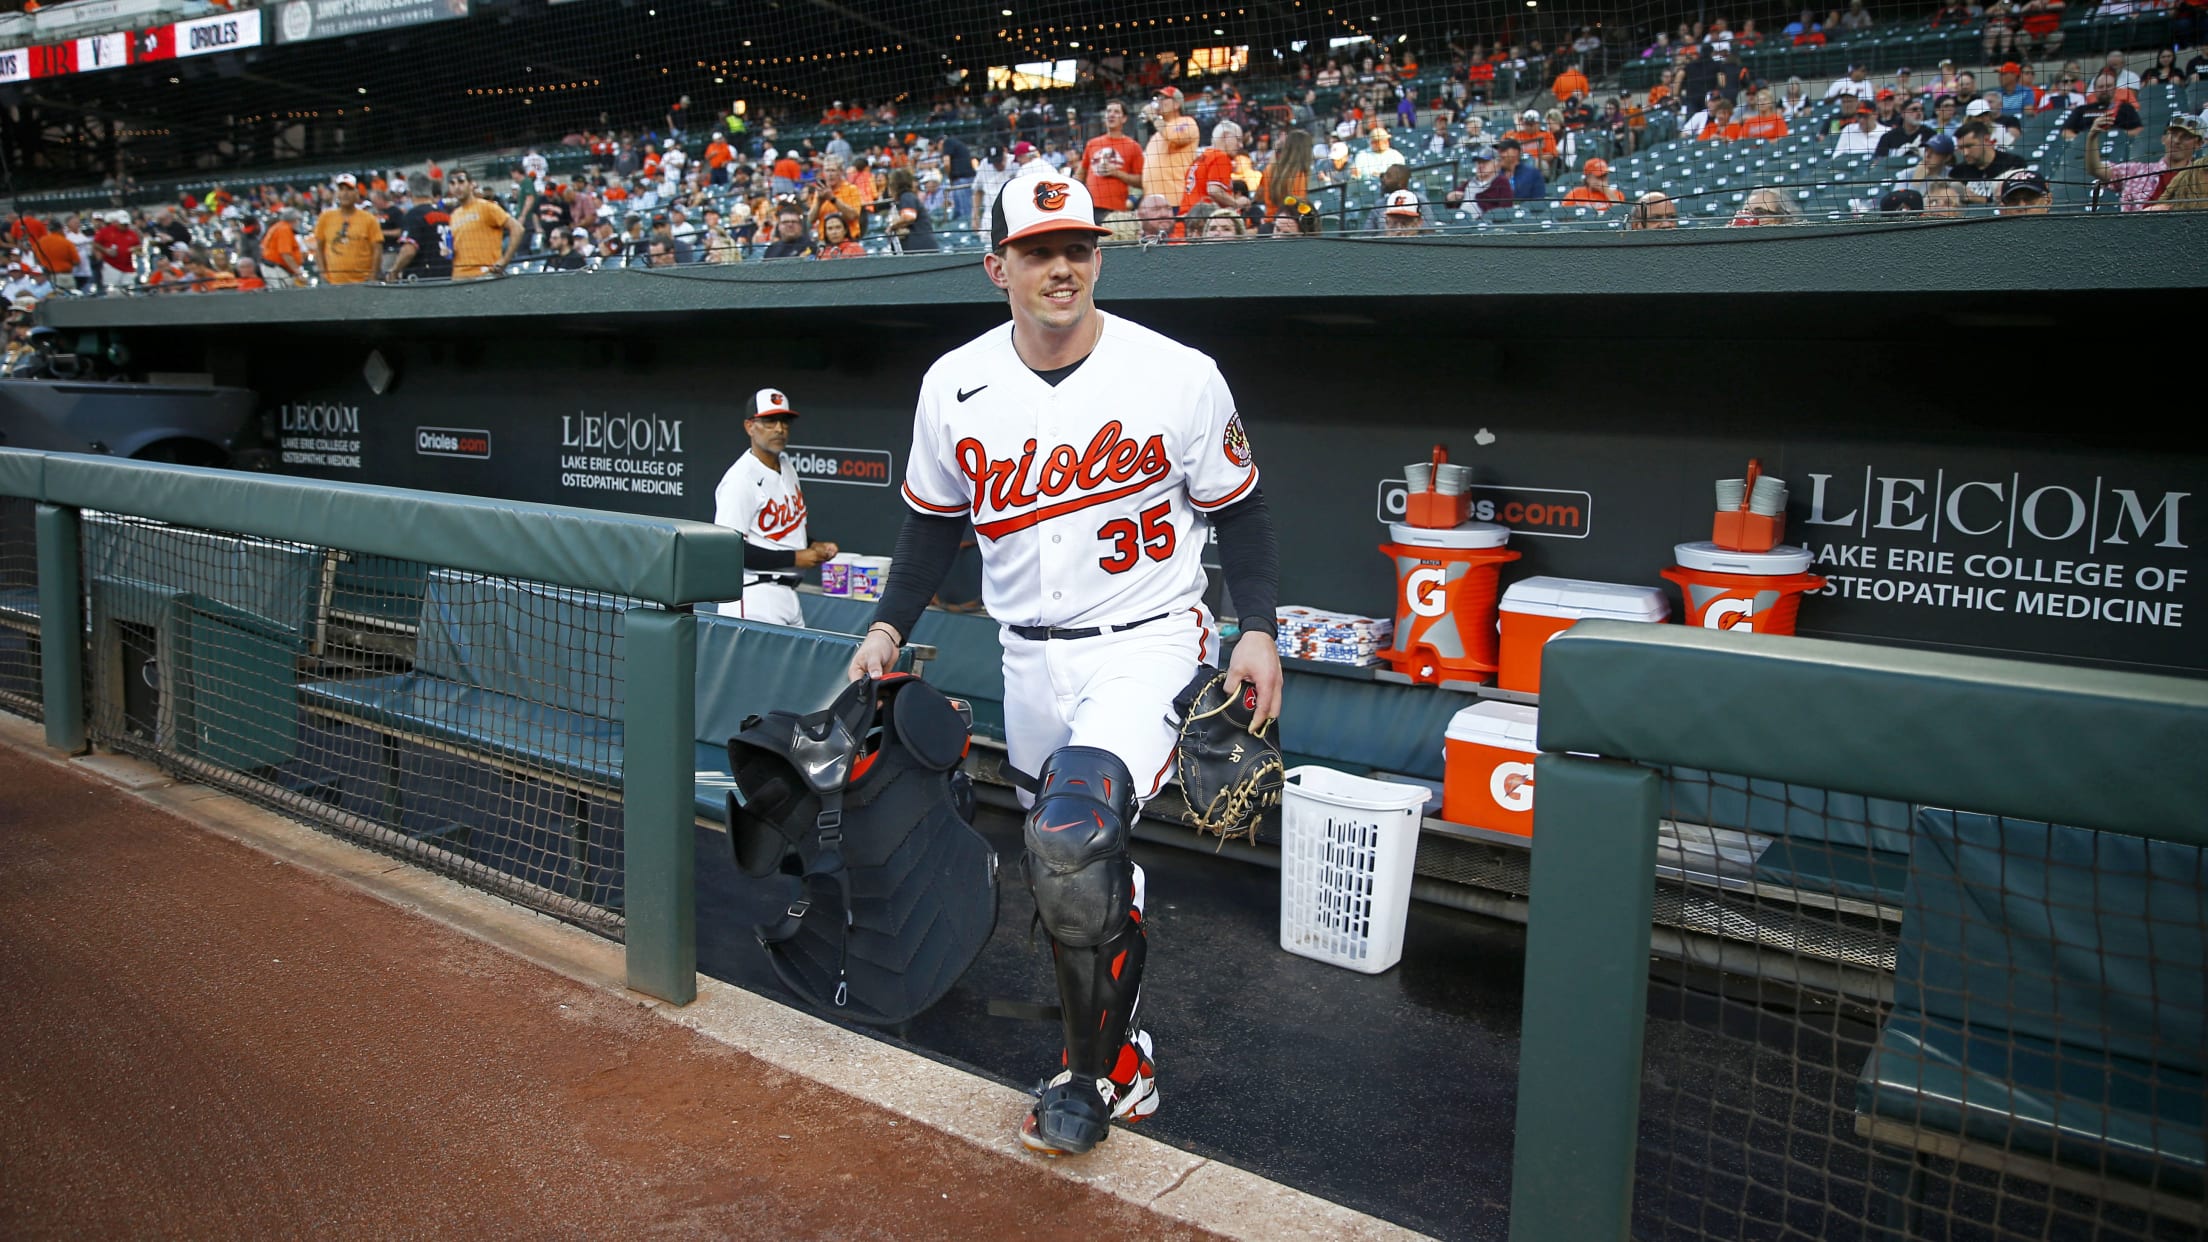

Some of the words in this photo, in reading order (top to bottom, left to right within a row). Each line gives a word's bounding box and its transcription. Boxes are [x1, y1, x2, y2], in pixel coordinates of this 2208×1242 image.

[191, 21, 238, 49] ORIOLES
[316, 439, 348, 452] COLLEGE
[349, 441, 361, 453] OF
[420, 432, 487, 453] Orioles.com
[562, 415, 684, 453] LECOM
[327, 454, 361, 468] MEDICINE
[562, 455, 587, 470] LAKE
[590, 457, 612, 472] ERIE
[614, 458, 665, 475] COLLEGE
[667, 462, 684, 477] OF
[956, 420, 1171, 517] Orioles
[562, 473, 630, 491] OSTEOPATHIC
[631, 479, 684, 496] MEDICINE
[1804, 472, 2192, 549] LECOM
[1097, 499, 1176, 575] 35
[1887, 548, 1954, 574] ERIE
[1964, 553, 2124, 588] COLLEGE
[2135, 565, 2188, 592] OF
[1406, 567, 1447, 617] G
[2015, 592, 2183, 627] MEDICINE
[1703, 597, 1755, 632] G
[1489, 761, 1534, 812] G
